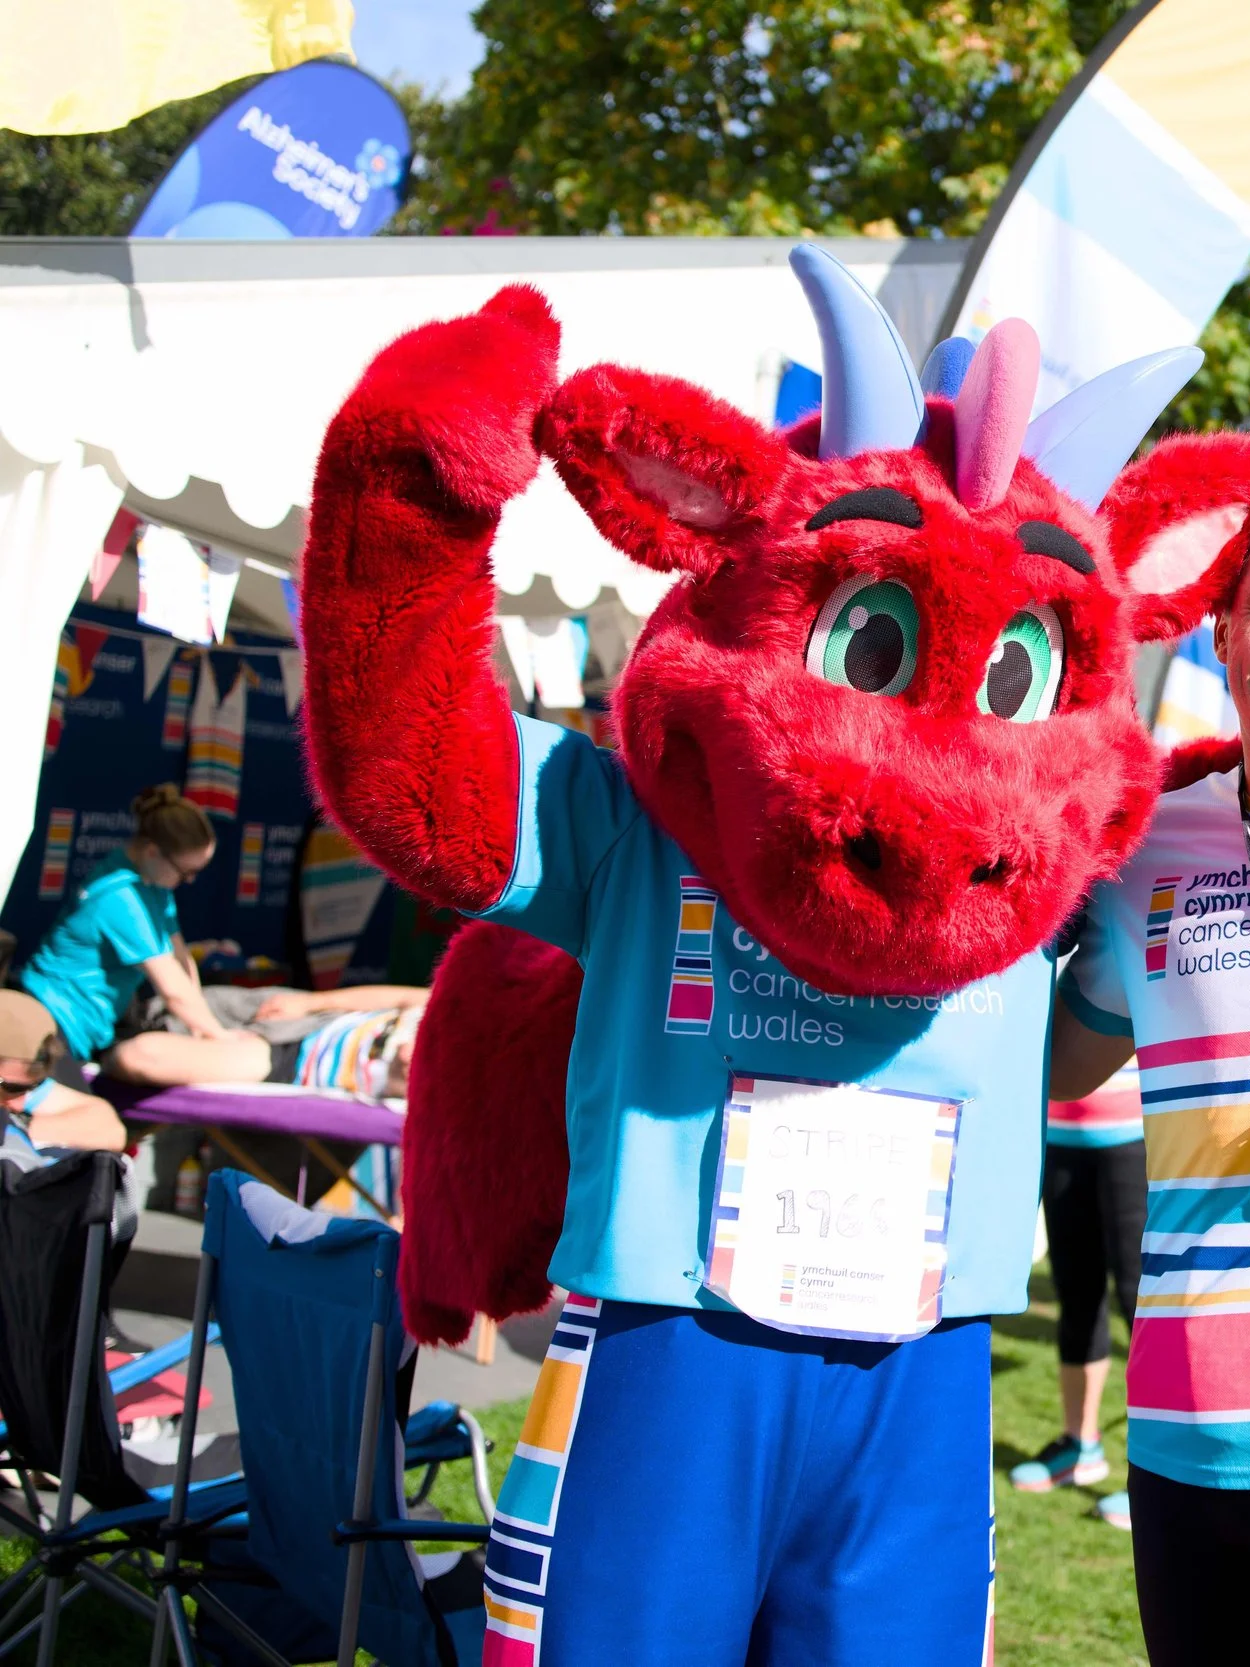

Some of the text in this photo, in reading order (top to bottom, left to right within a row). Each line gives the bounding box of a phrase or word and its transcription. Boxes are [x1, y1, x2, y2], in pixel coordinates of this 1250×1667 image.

[728, 1009, 844, 1047] wales
[767, 1124, 912, 1167] STRIPE
[800, 1277, 835, 1288] cymru
[802, 1264, 885, 1282] ymchwil canser
